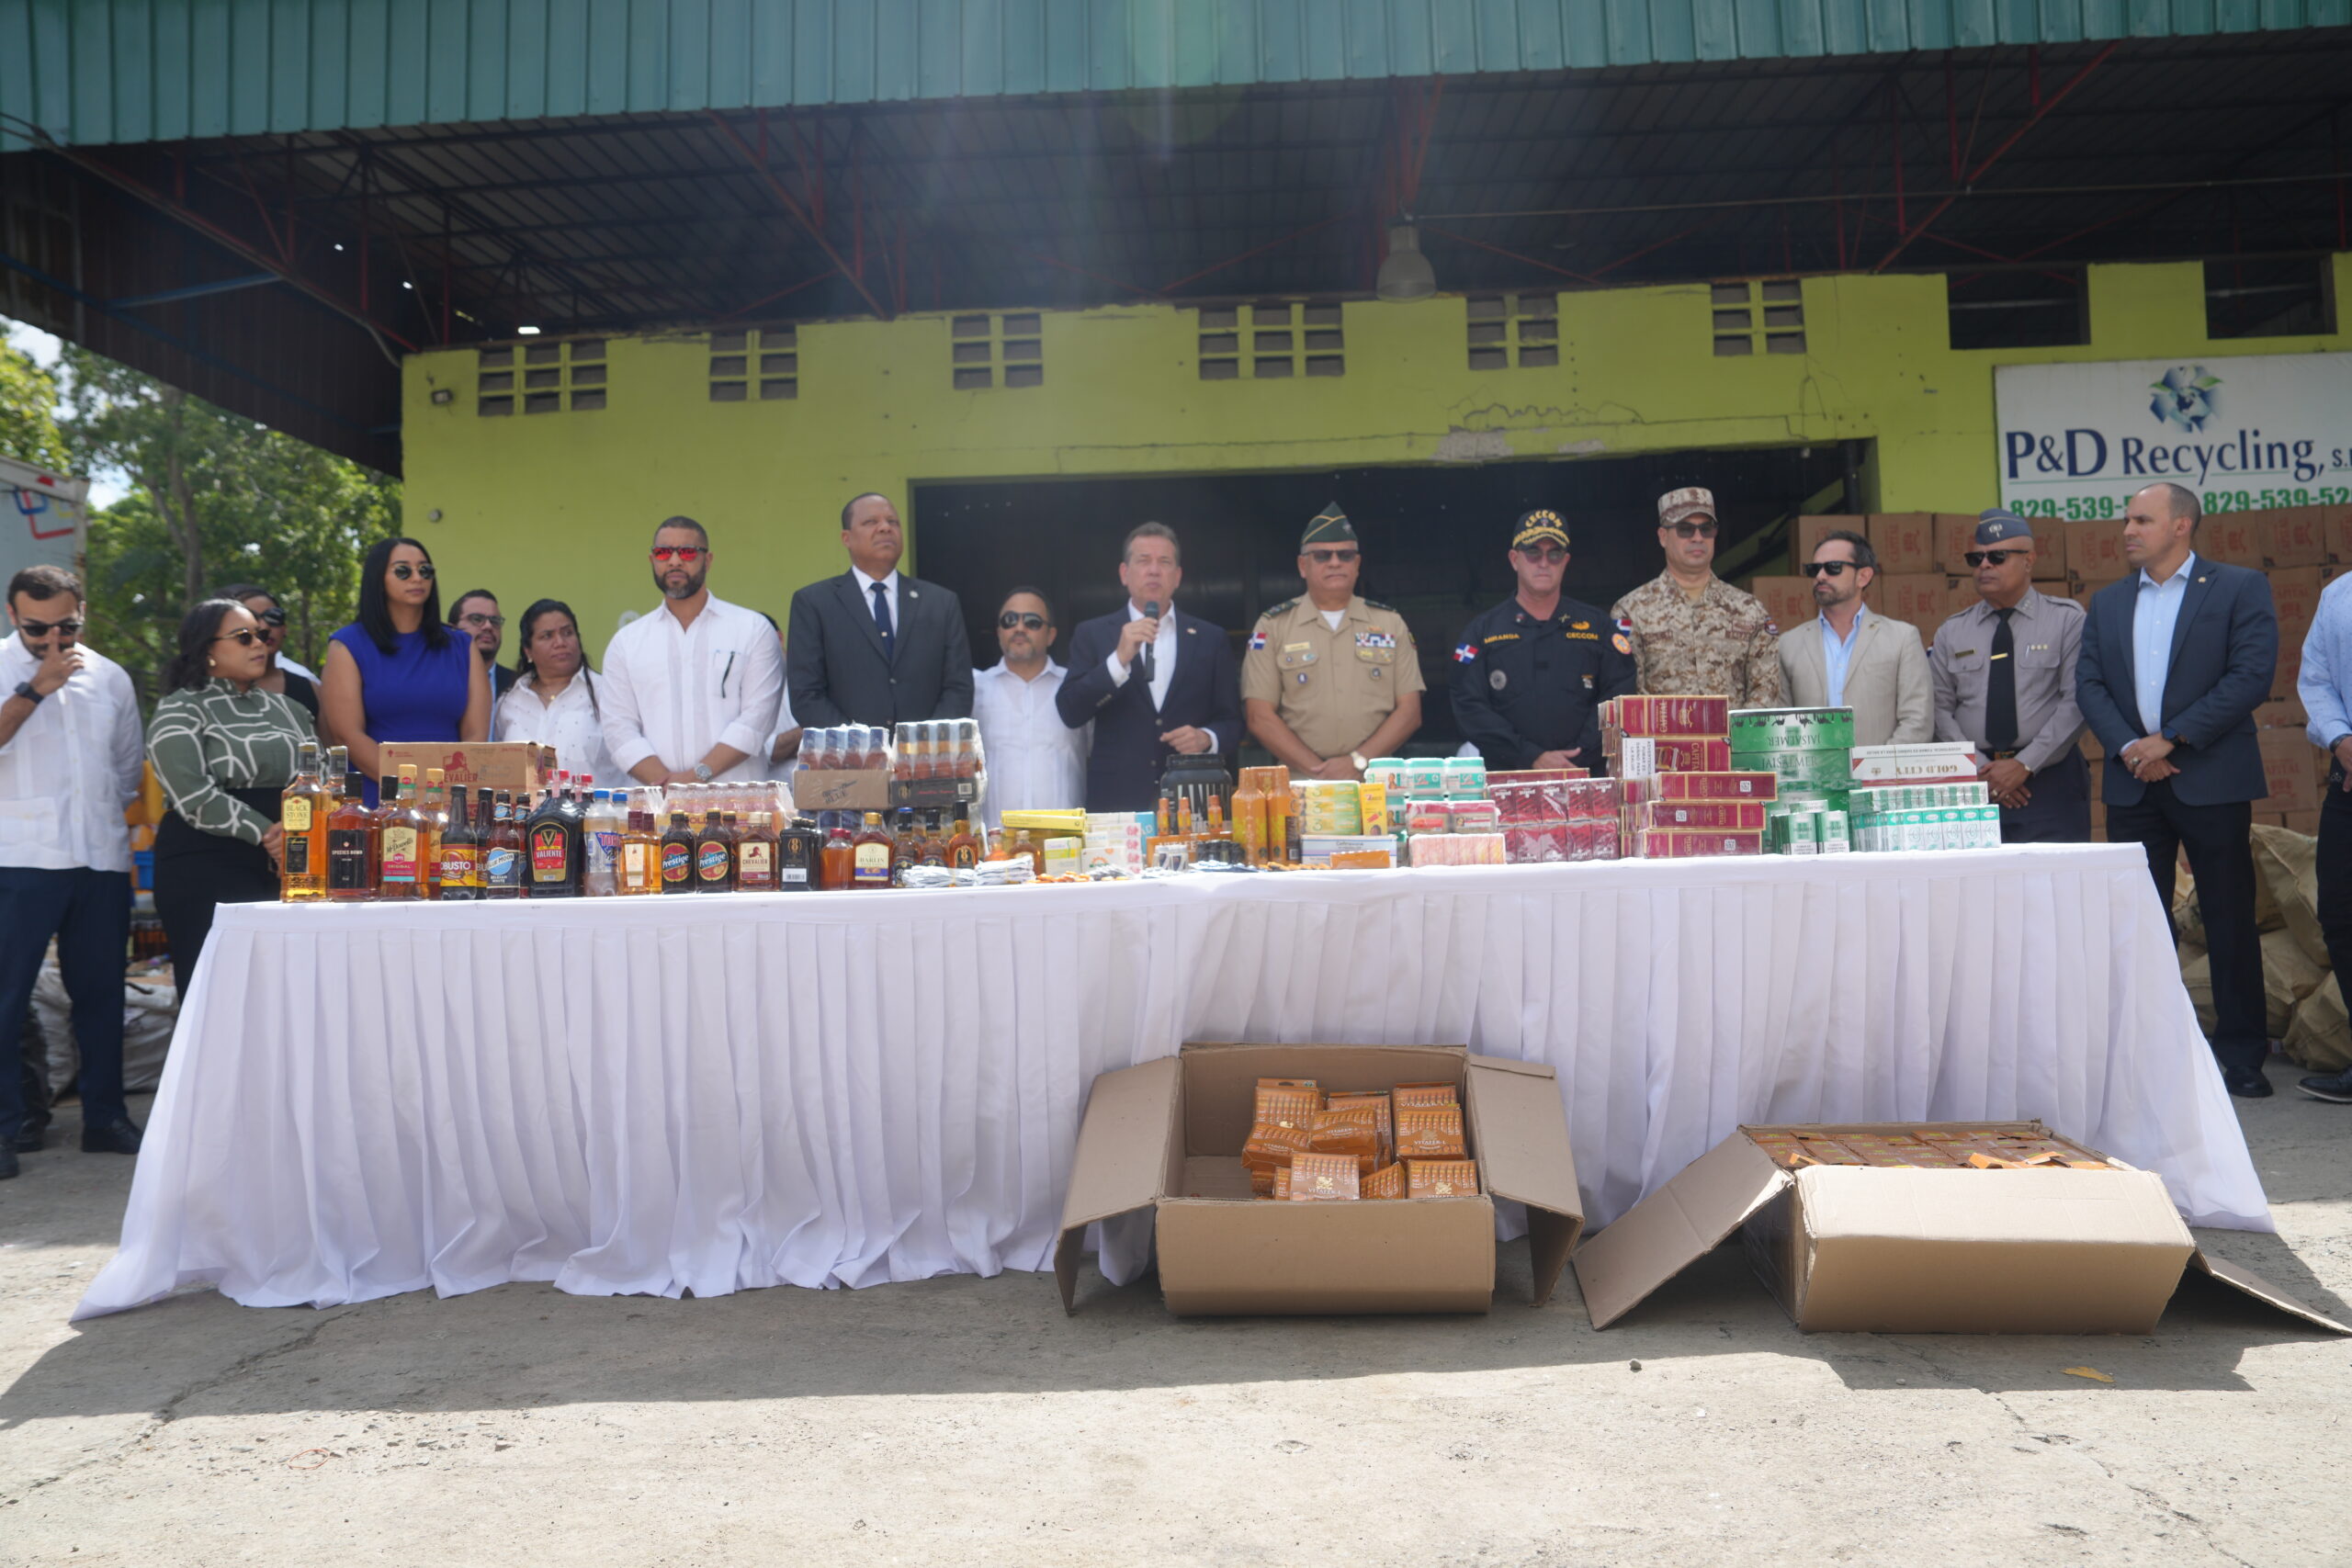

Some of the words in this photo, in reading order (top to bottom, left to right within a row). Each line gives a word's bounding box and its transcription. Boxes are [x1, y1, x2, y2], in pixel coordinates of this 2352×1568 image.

[2006, 428, 2108, 479] P&D
[2121, 429, 2324, 486] Recycling,
[2203, 487, 2352, 514] 829-539-52
[1525, 510, 1562, 527] CECCOM
[1484, 633, 1521, 644] MIRANDA
[1566, 632, 1599, 640] CECCOM
[1659, 701, 1668, 733] CAPITAL
[1768, 733, 1821, 747] JAISALMER
[1763, 756, 1817, 769] JAISALMER
[1926, 764, 1958, 773] GOLD
[1895, 765, 1923, 775] CITY
[444, 772, 478, 783] EVALIER
[498, 853, 514, 863] MOON
[536, 850, 562, 858] VALIENTE
[440, 861, 470, 872] OBUSTO
[662, 853, 689, 869] Prestige
[699, 852, 727, 869] Prestige
